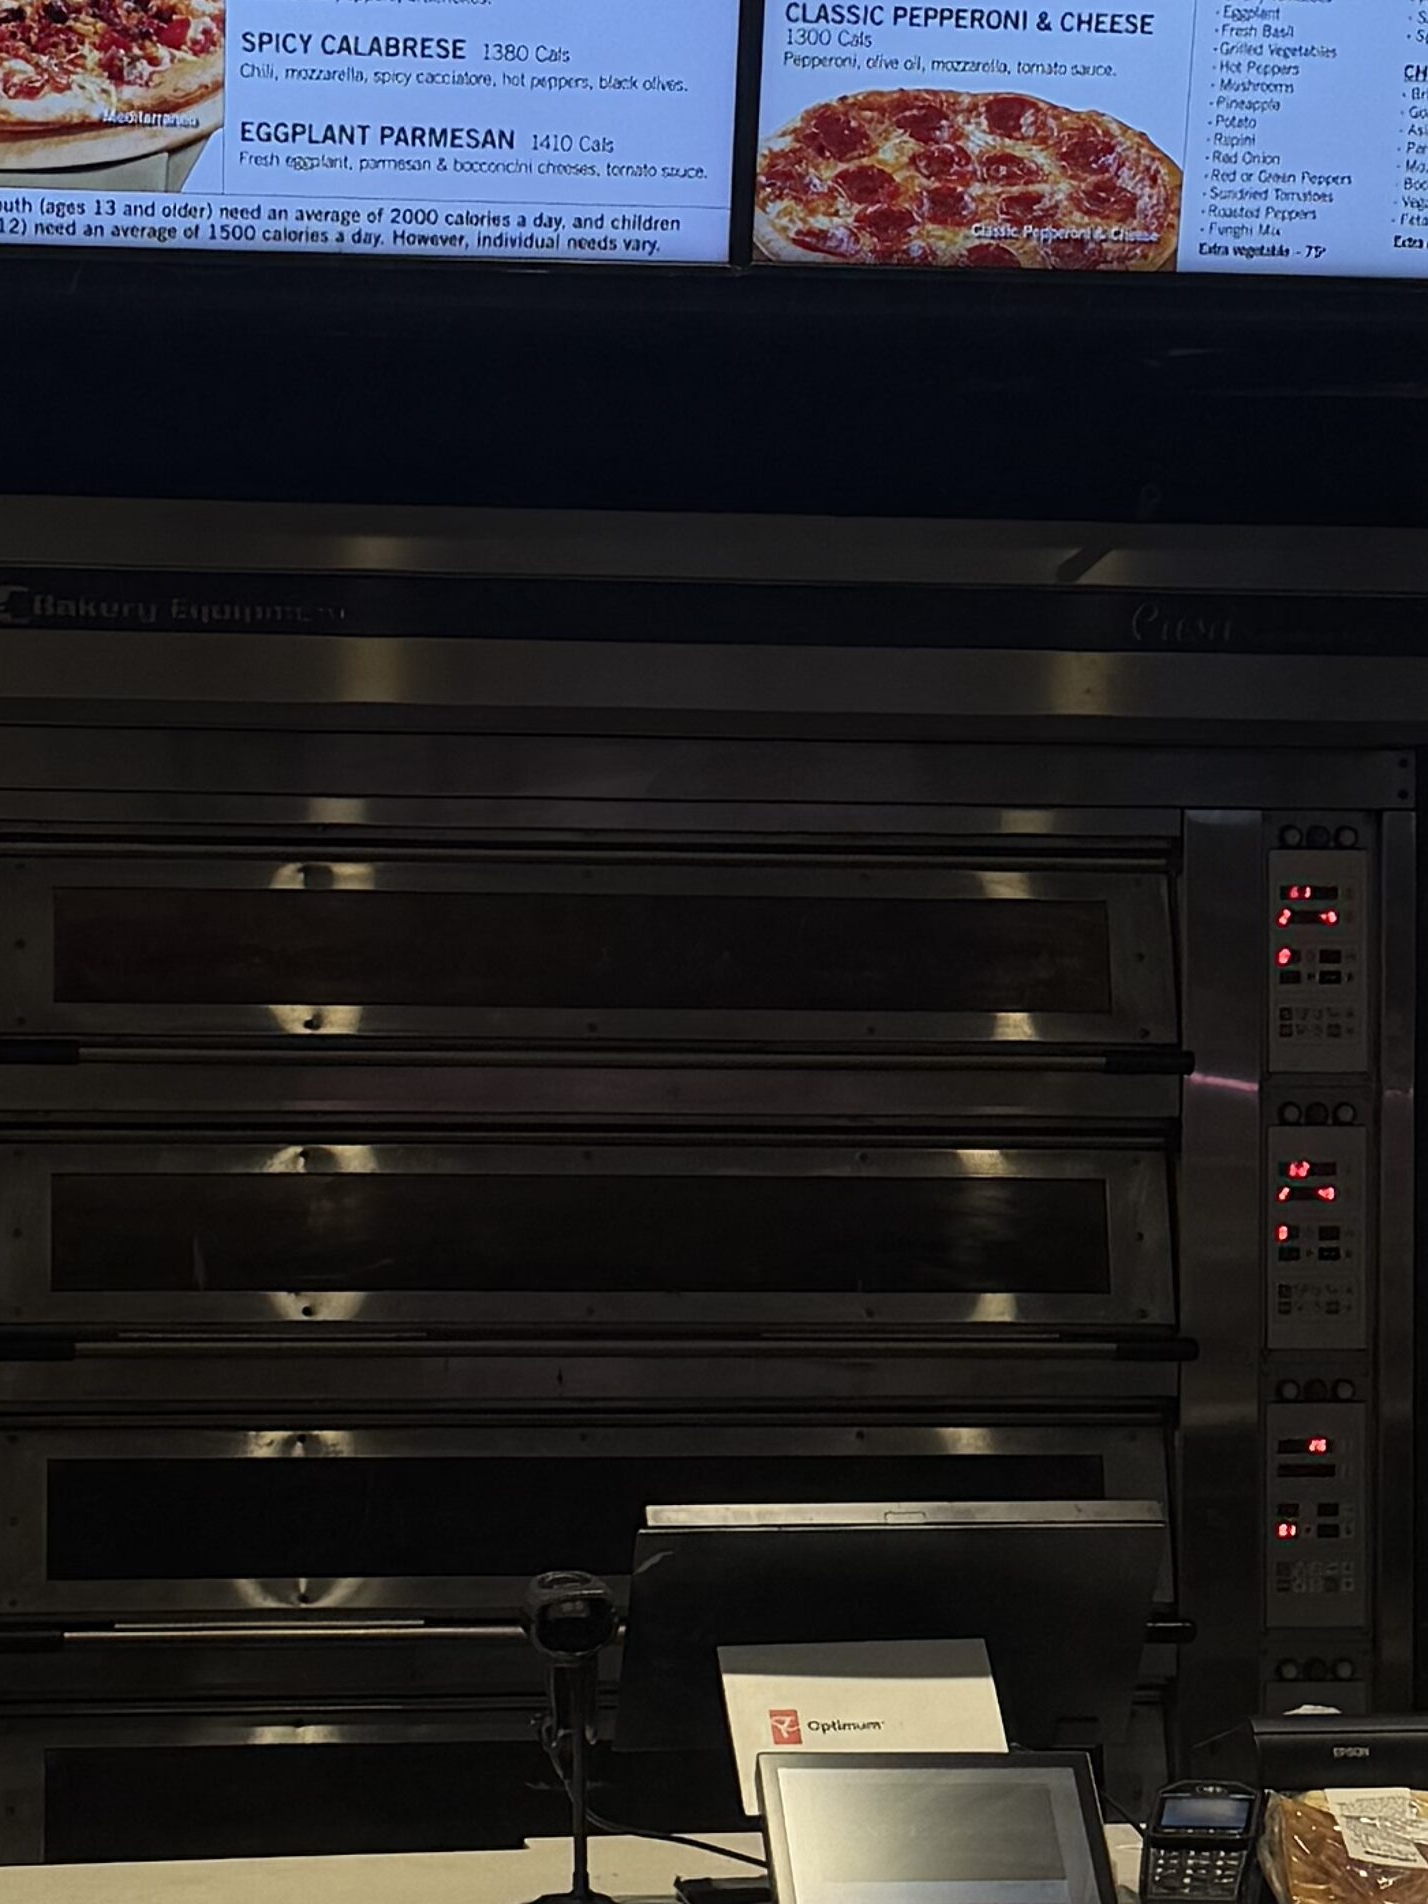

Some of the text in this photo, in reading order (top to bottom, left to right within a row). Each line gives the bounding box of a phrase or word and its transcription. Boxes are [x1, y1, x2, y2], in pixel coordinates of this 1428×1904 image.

[784, 2, 1155, 35] CLASSIC PEPPERONI & CHEESE
[241, 32, 570, 63] SPICY CALABRESE 1380 Cals
[786, 27, 872, 48] 1300 Cals
[240, 121, 614, 154] EGGPLANT PARMESAN 1410 Cals
[807, 1719, 882, 1735] Optimum
[1332, 1746, 1370, 1758] EPSON
